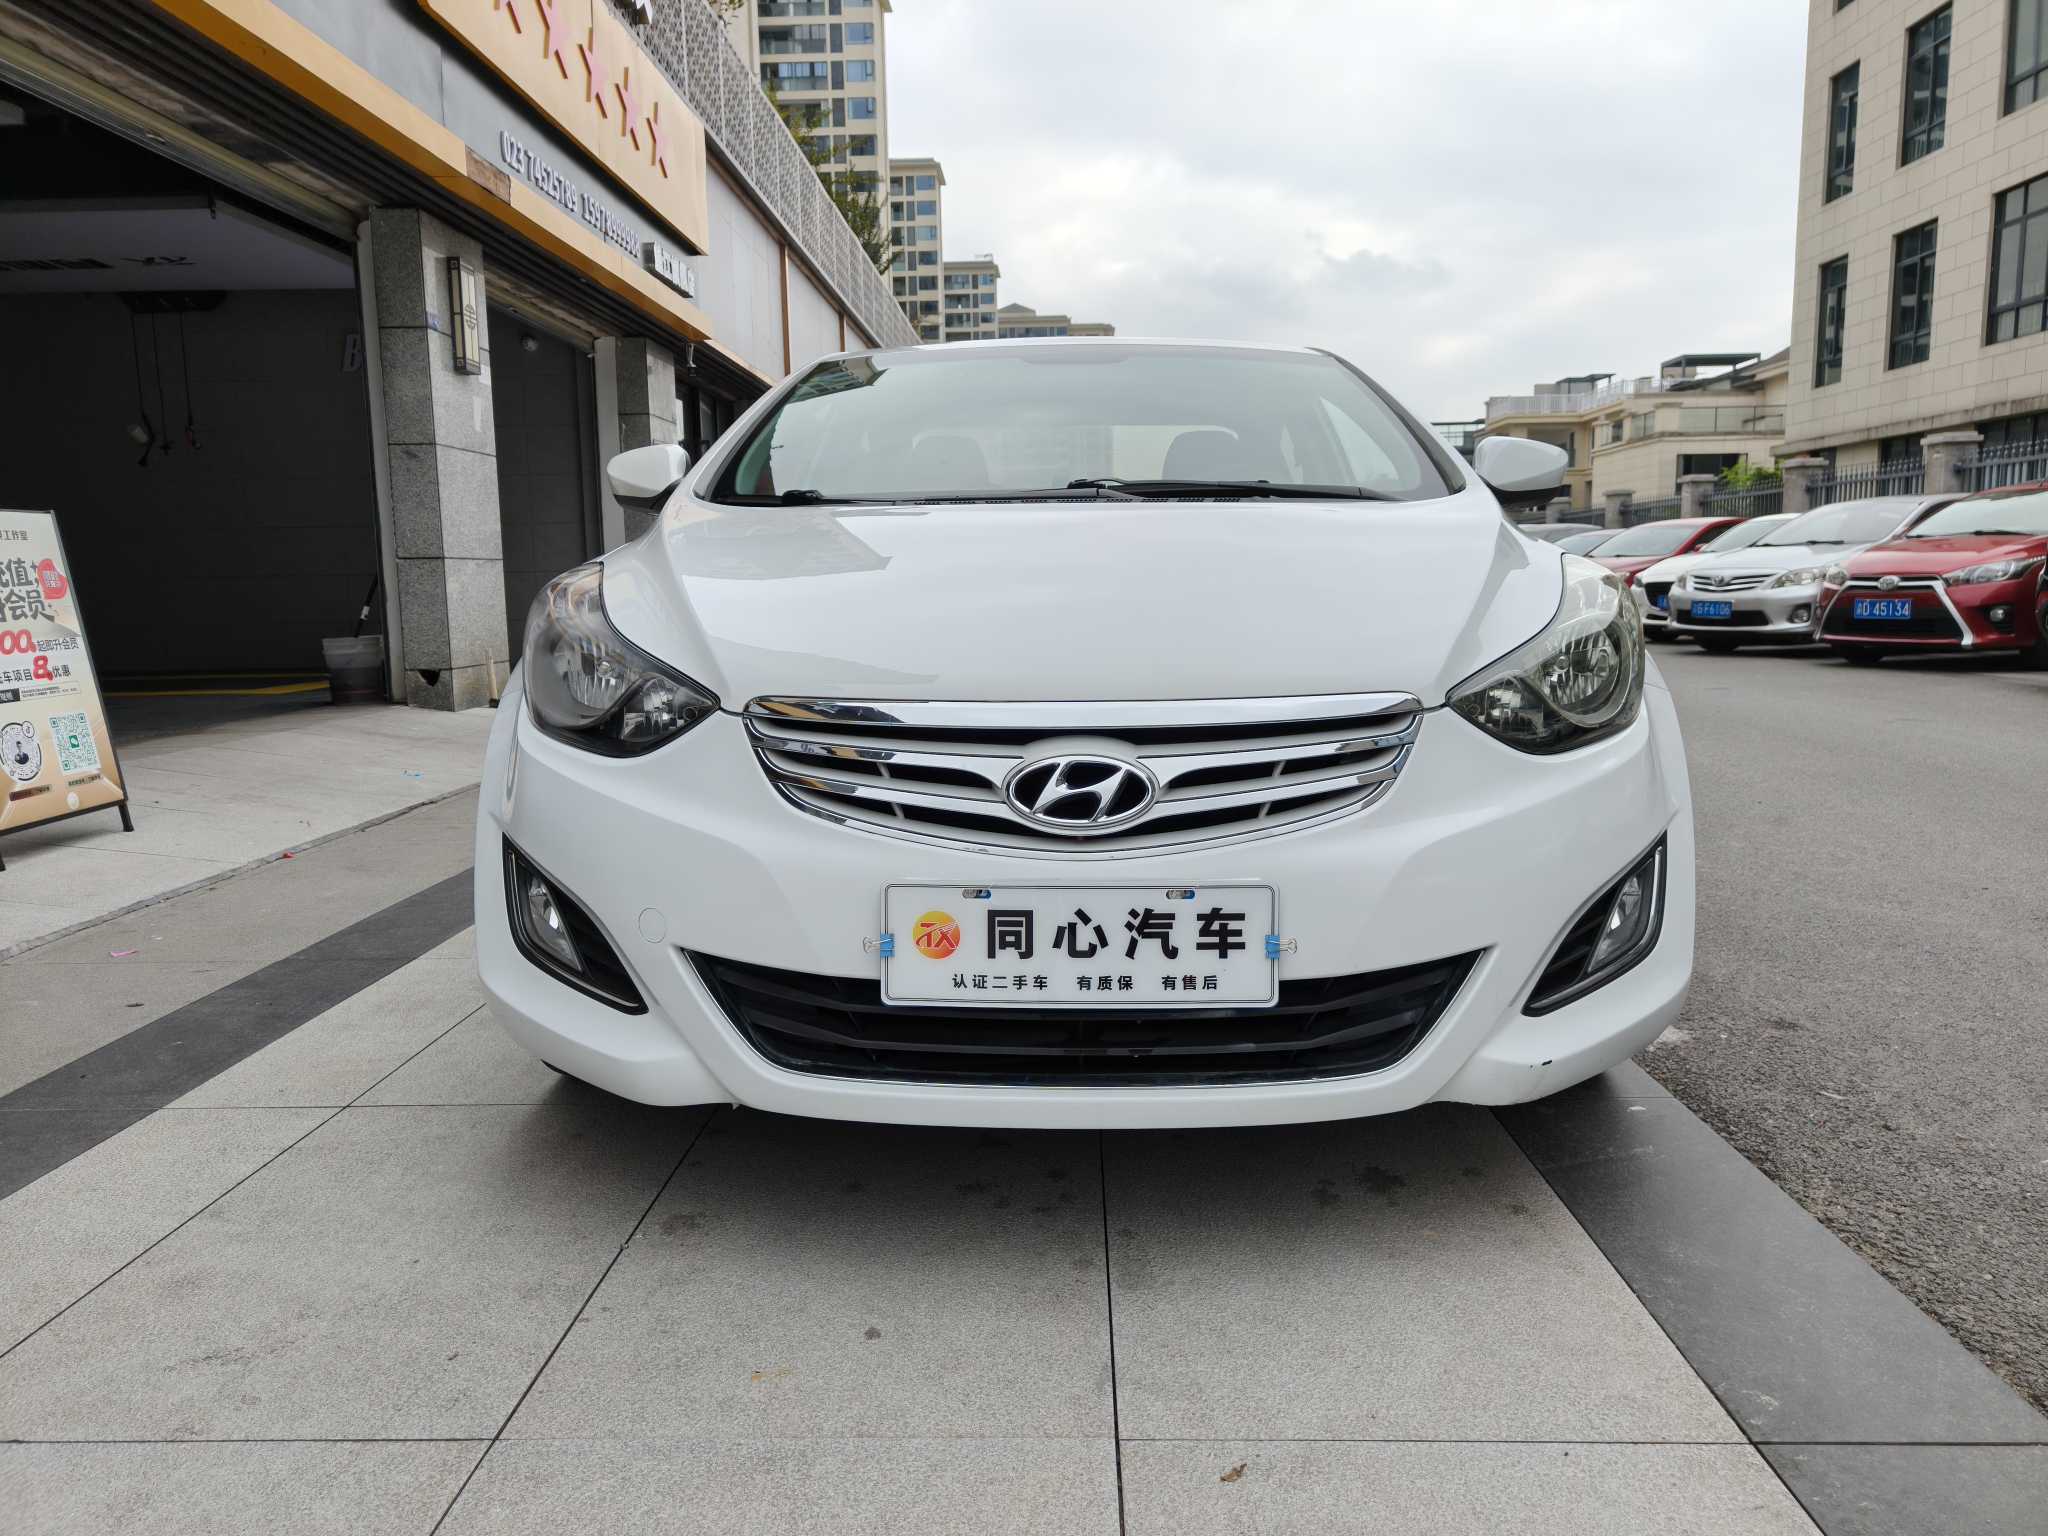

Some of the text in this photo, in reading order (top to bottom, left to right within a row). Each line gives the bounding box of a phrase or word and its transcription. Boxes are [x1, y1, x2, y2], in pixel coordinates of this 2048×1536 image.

[500, 130, 525, 175] 023
[986, 907, 1247, 960] 同心汽车
[951, 973, 1219, 991] 认证二手车 有质保 有售后
